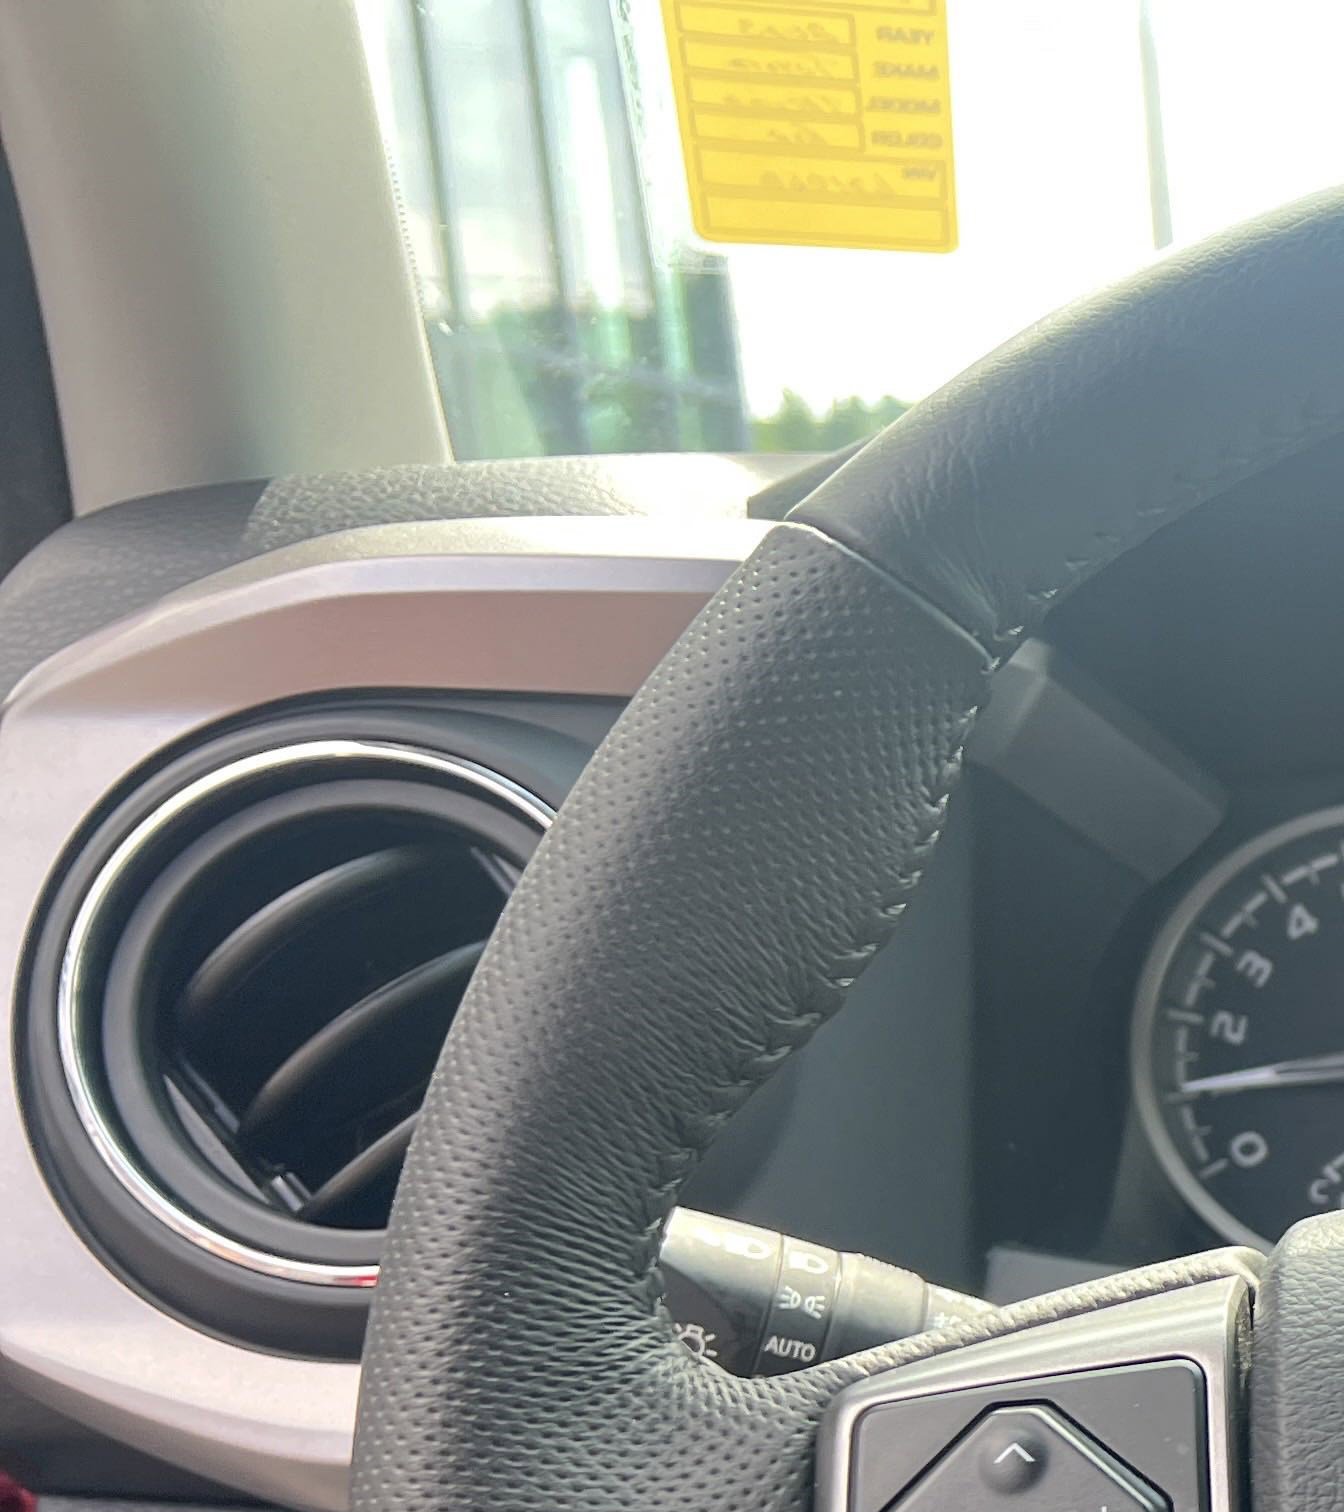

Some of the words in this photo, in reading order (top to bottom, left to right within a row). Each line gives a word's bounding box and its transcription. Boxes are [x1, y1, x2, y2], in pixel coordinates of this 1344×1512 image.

[1287, 905, 1320, 940] 4
[1236, 949, 1274, 987] 3
[1209, 1010, 1249, 1046] 2
[1229, 1131, 1268, 1168] 0
[764, 1334, 817, 1363] AUTO
